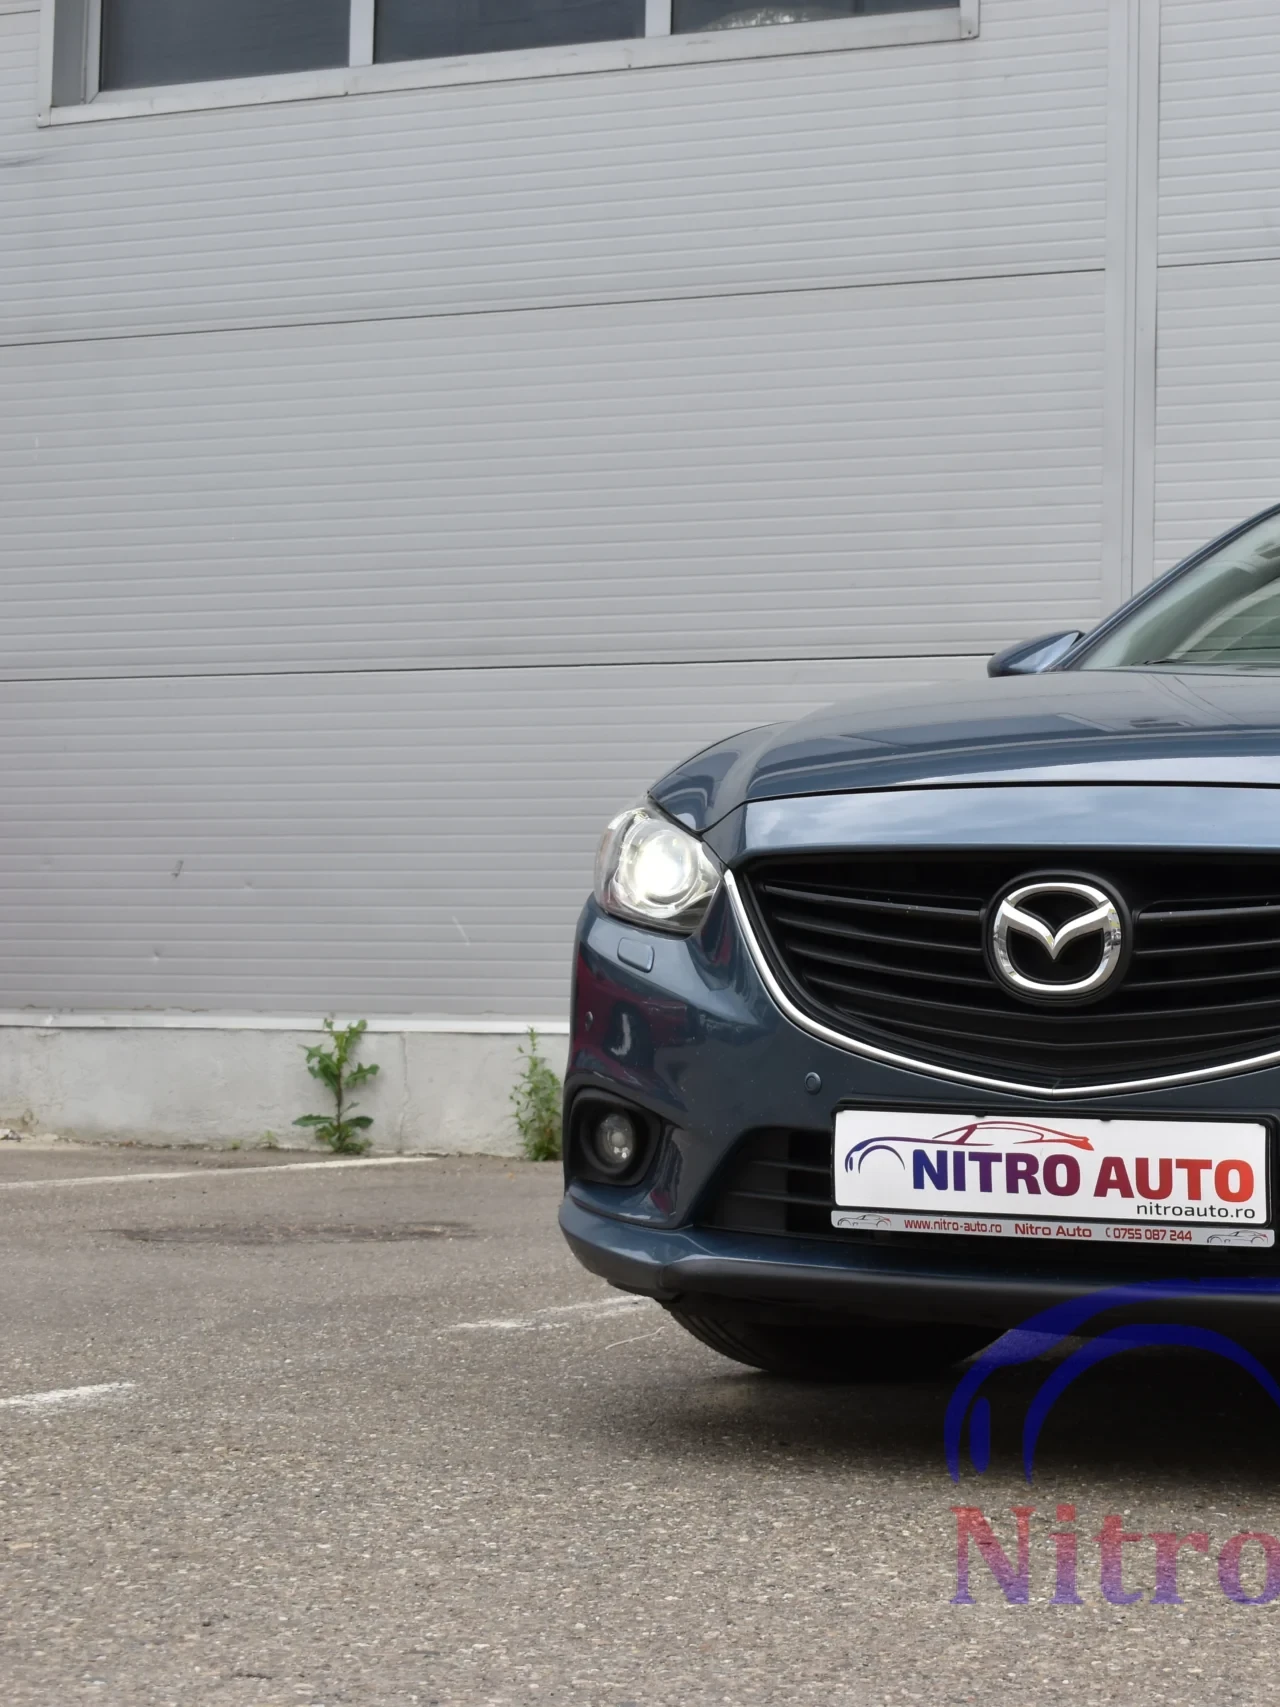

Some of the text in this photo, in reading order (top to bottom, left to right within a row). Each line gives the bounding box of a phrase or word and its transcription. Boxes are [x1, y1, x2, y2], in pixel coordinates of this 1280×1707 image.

[911, 1149, 1254, 1203] NITRO AUTO
[1136, 1202, 1256, 1219] nitroauto.ro
[904, 1218, 1193, 1242] www.nitro-auto.ro Nitro Auto 0755 087 244
